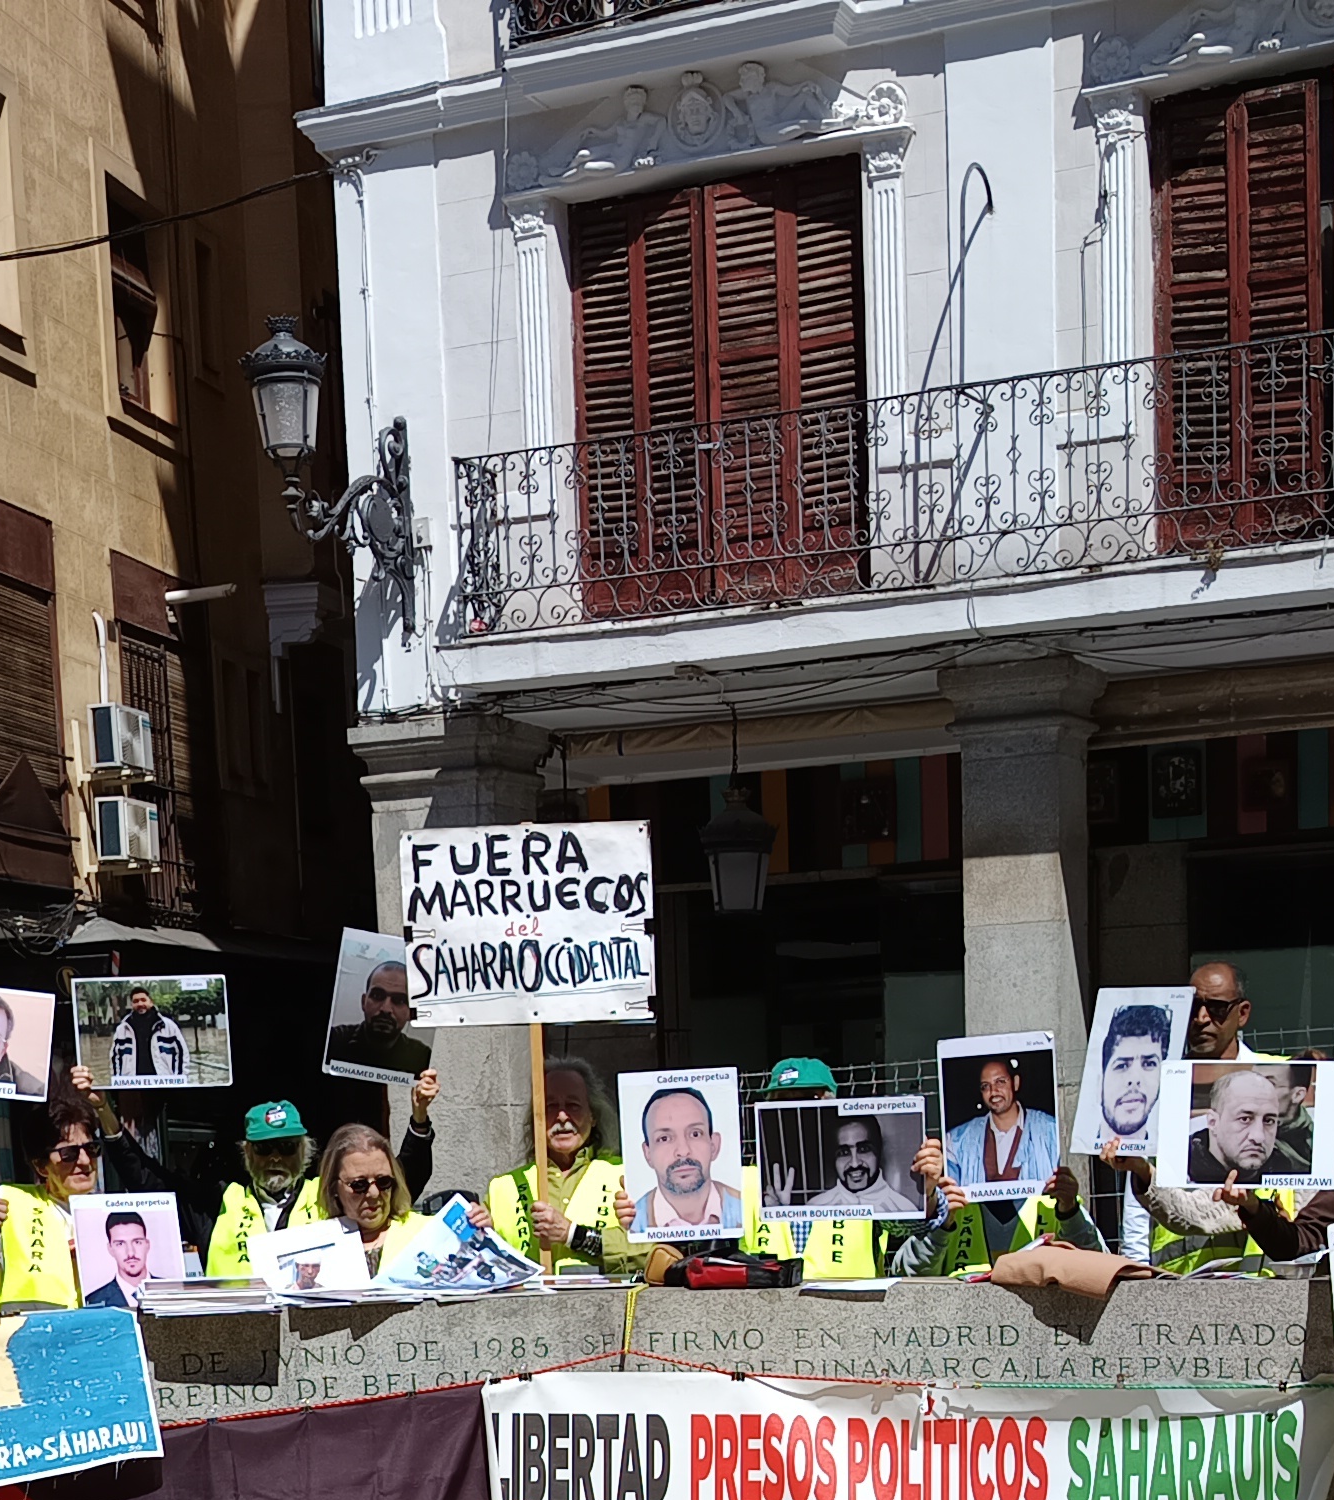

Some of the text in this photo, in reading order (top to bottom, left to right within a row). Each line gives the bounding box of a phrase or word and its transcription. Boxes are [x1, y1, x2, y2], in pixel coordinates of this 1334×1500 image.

[412, 831, 588, 883] FUERA
[408, 872, 648, 922] MARRUECOS
[505, 917, 542, 937] del
[331, 1064, 410, 1084] MOHAMED BOURIAL
[657, 1072, 730, 1084] Cadena perpetua
[842, 1101, 917, 1111] Cadena perpetua
[1263, 1176, 1333, 1186] HUSSEIN ZAWI
[971, 1186, 1035, 1199] NAAMA ASFARI
[136, 1199, 170, 1207] perpetua
[764, 1207, 873, 1219] EL BACHIR BOUTENGUIZA
[516, 1183, 531, 1253] SAHARA
[28, 1208, 44, 1272] SAHARA
[648, 1228, 721, 1239] MOHAMED BANI
[180, 1353, 228, 1377] DE
[395, 1341, 440, 1362] DE
[472, 1337, 549, 1359] 1985
[648, 1329, 764, 1352] FIRMO
[796, 1327, 841, 1349] EN
[872, 1325, 1020, 1348] MADRID
[1054, 1325, 1094, 1346] EL
[1132, 1323, 1308, 1346] TRATADO
[158, 1383, 273, 1409] REINO
[296, 1377, 340, 1400] DE
[1092, 1357, 1305, 1379] REPVBLICA
[42, 1421, 147, 1461] SAHARAUI
